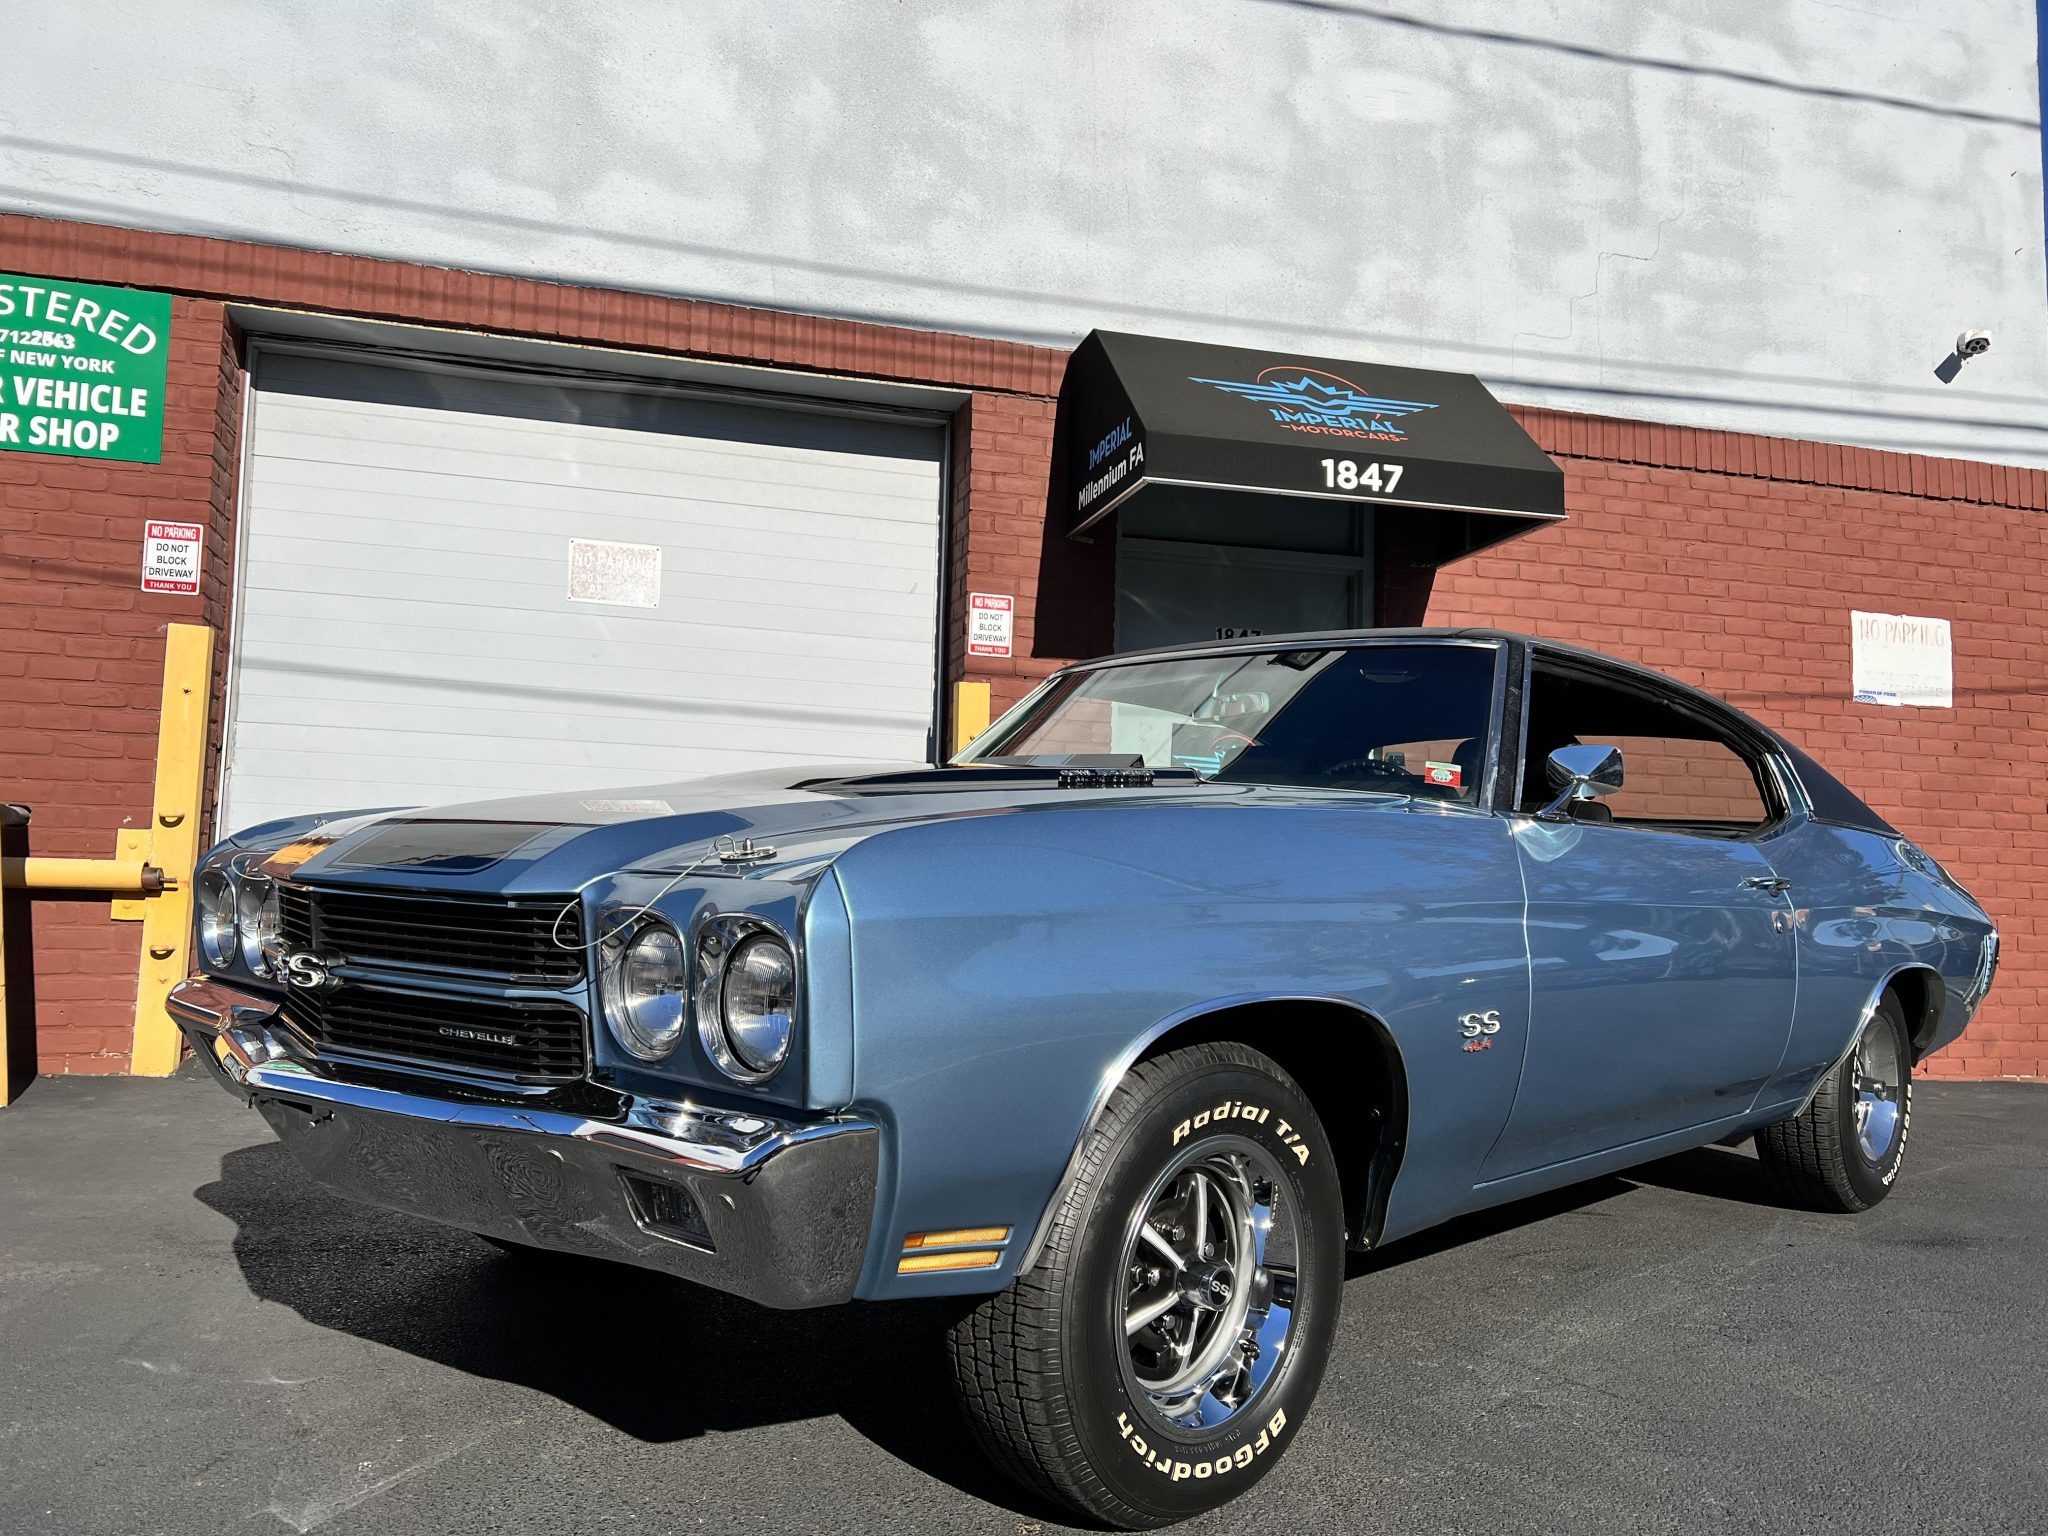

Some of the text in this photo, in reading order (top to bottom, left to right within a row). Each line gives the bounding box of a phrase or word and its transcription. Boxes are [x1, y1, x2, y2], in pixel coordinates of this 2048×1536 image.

[10, 350, 56, 367] NEW
[61, 354, 116, 374] YORK
[13, 376, 148, 417] VEHICLE
[1268, 408, 1405, 434] IMPERIAL
[28, 415, 120, 451] SHOP
[1290, 424, 1400, 442] MOTORCARS
[1088, 416, 1132, 471] IMPERIAL
[1078, 442, 1144, 511] Millennium FA
[1321, 458, 1404, 494] 1847
[151, 525, 197, 540] NO PARKING
[156, 543, 189, 553] DO NOT
[156, 555, 187, 566] BLOCK
[148, 567, 194, 578] DRIVEWAY
[149, 581, 175, 589] THANK
[974, 597, 1009, 609] NO PARKING
[990, 613, 1003, 621] NOT
[979, 623, 1002, 632] BLOCK
[1860, 619, 1880, 641] NO
[973, 633, 1007, 642] DRIVEWAY
[974, 645, 993, 653] THANK
[1461, 1010, 1500, 1037] SS
[438, 1027, 513, 1046] CHEVELLE
[1172, 1101, 1270, 1146] Radial
[1211, 1280, 1230, 1297] SS
[1117, 1408, 1287, 1482] BFGoodrich
